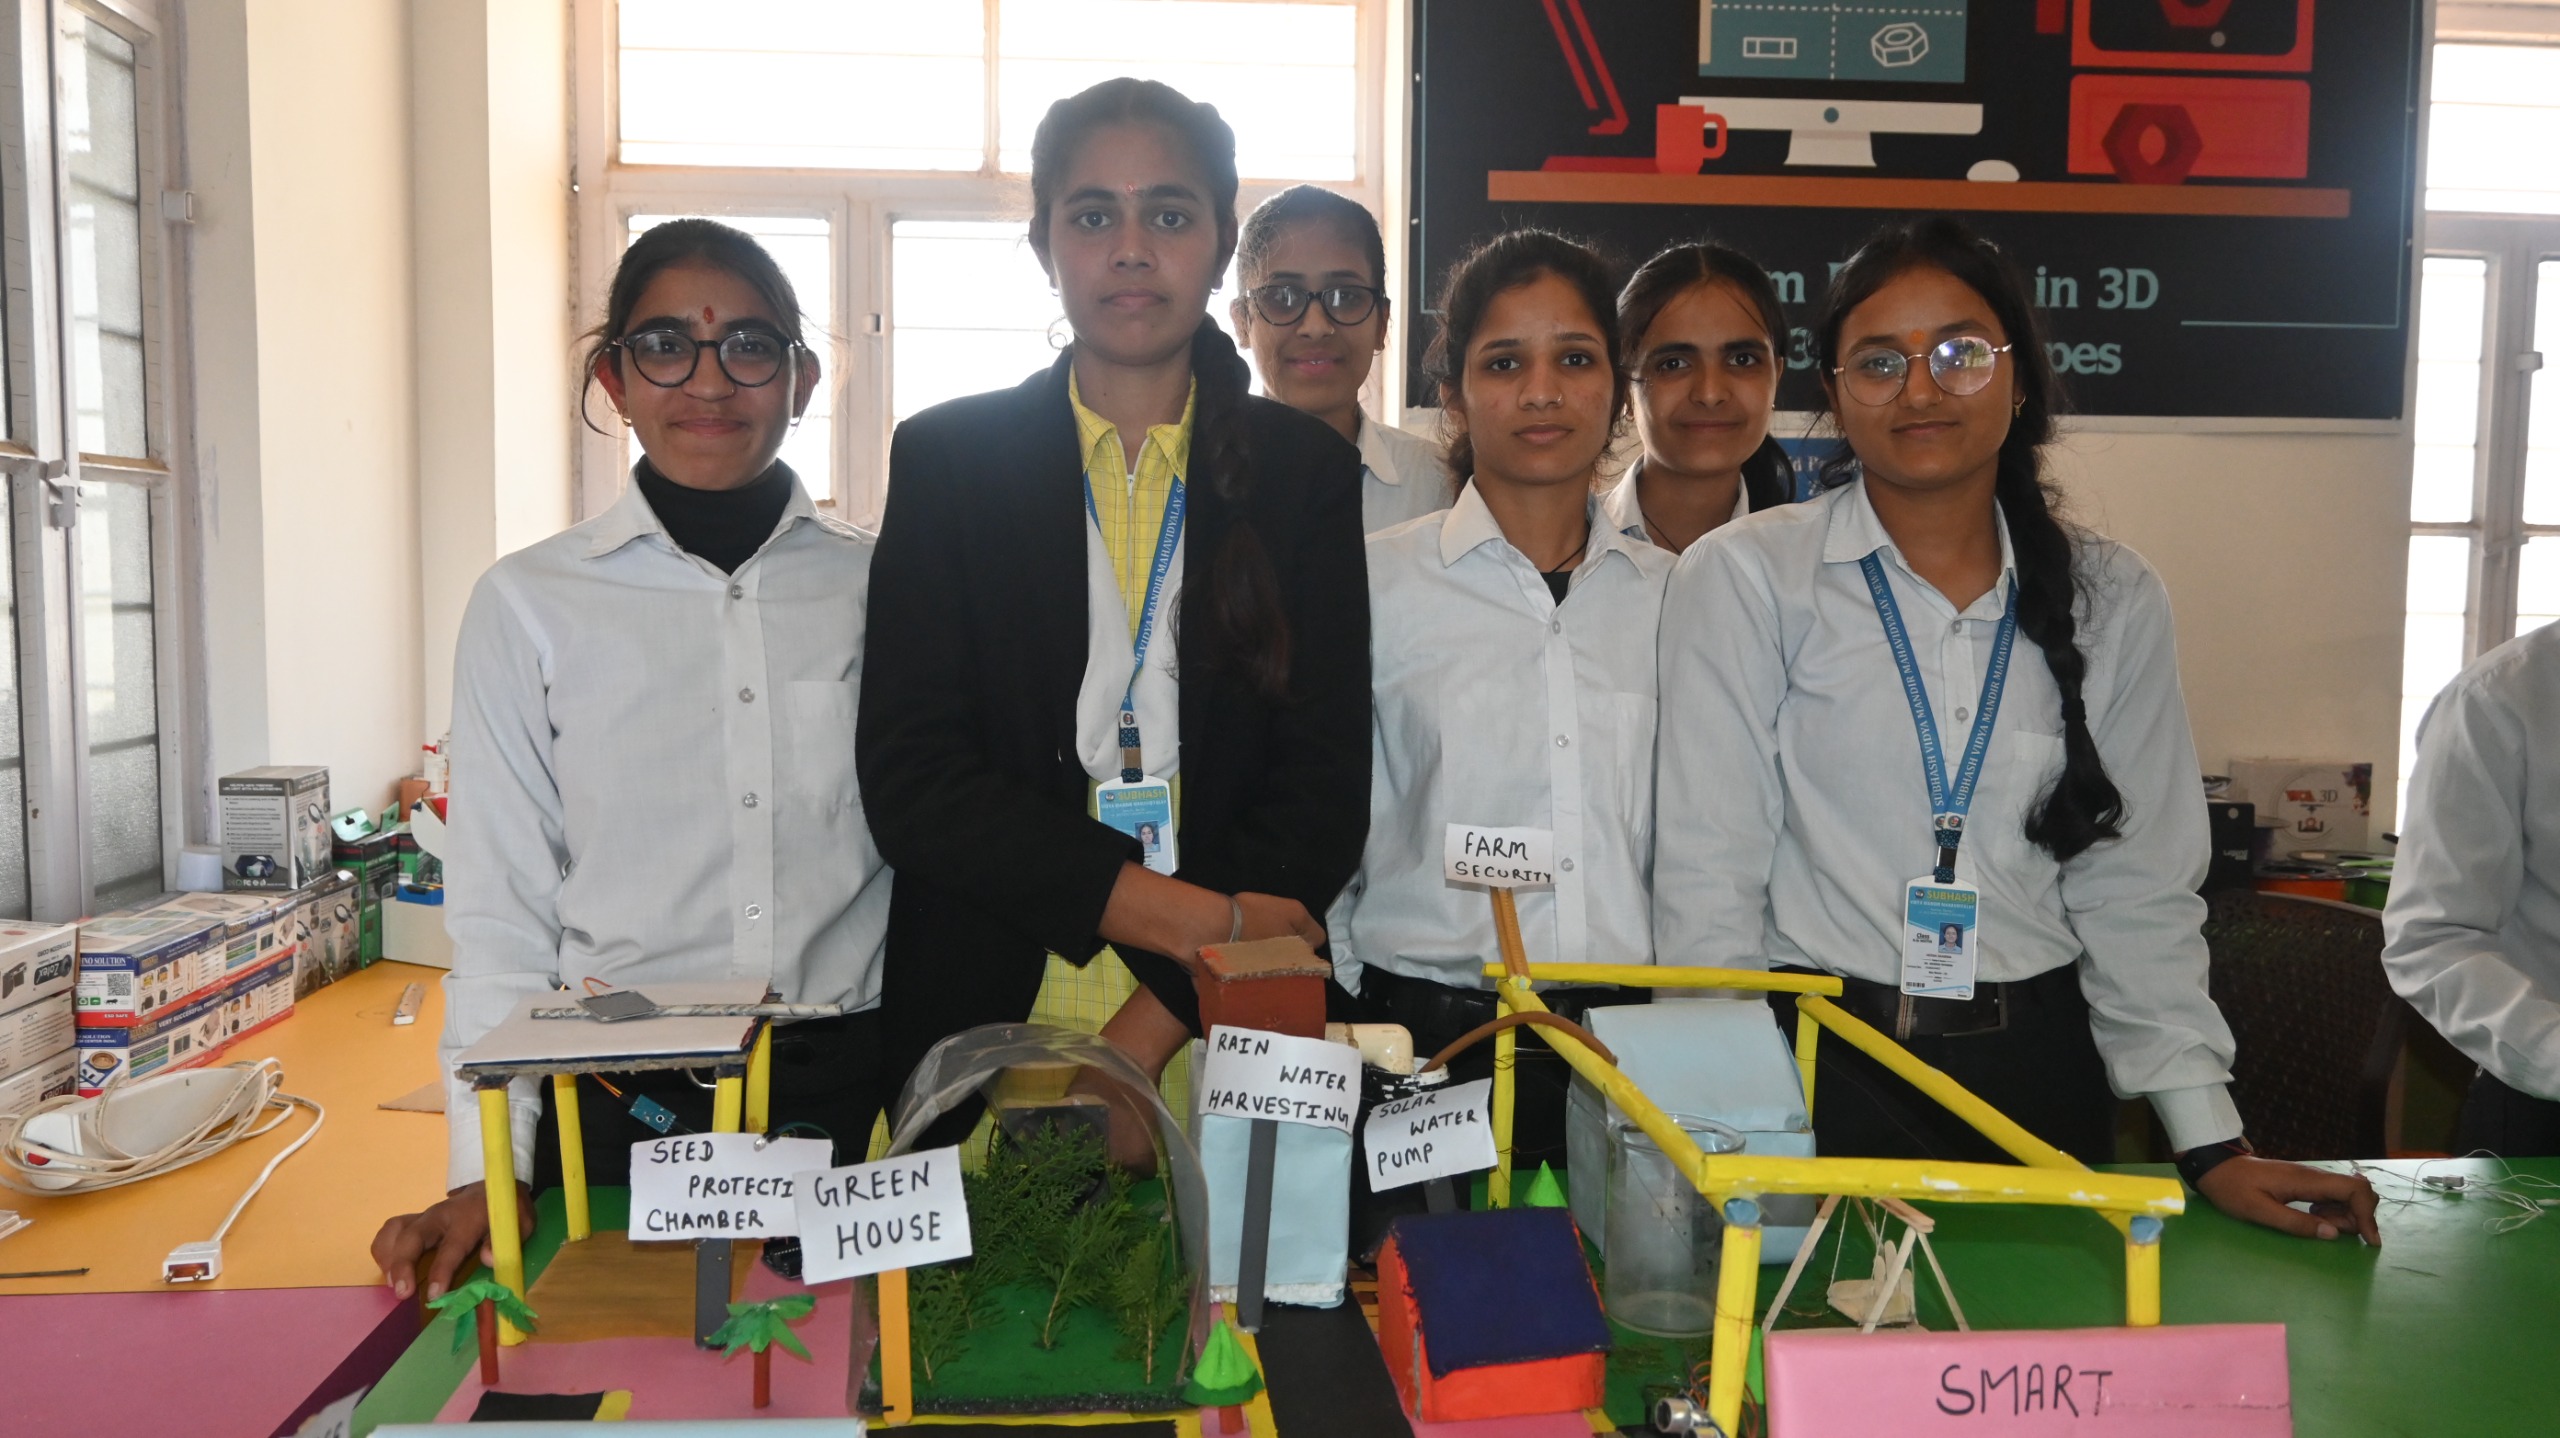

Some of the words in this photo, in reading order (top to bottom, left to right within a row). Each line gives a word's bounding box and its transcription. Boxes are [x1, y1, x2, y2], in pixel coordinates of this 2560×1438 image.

[2034, 265, 2079, 308] in
[2097, 267, 2159, 310] 3D
[1138, 620, 1154, 651] VIDYA
[1147, 575, 1164, 618] MANDIR
[1906, 675, 1926, 719] MANDIR
[1919, 720, 1934, 754] VIDYA
[1955, 757, 1978, 807] SUBHASH
[1971, 724, 1988, 756] VIDYA
[1982, 680, 2000, 723] MANDIR
[1927, 755, 1944, 807] SUBHASH
[2319, 789, 2338, 803] 3D
[1465, 831, 1528, 861] FARM
[1455, 861, 1552, 885] SECURITY
[1927, 891, 1975, 902] SUBHASH
[94, 957, 127, 967] SOLUTION
[158, 1018, 173, 1028] VERY
[173, 1005, 204, 1022] SUCCESSFUL
[1217, 1031, 1270, 1056] RAIN
[1279, 1066, 1346, 1092] WATER
[1208, 1089, 1350, 1127] HARVESTING
[1378, 1092, 1437, 1119] SOLAR
[1410, 1108, 1480, 1137] WATER
[650, 1140, 714, 1164] SEED
[1376, 1142, 1434, 1177] PUMP
[688, 1174, 793, 1199] PROTECTI
[815, 1160, 930, 1209] GREEN
[646, 1208, 765, 1232] CHAMBER
[836, 1211, 942, 1261] HOUSE
[1936, 1363, 2114, 1418] SMART
